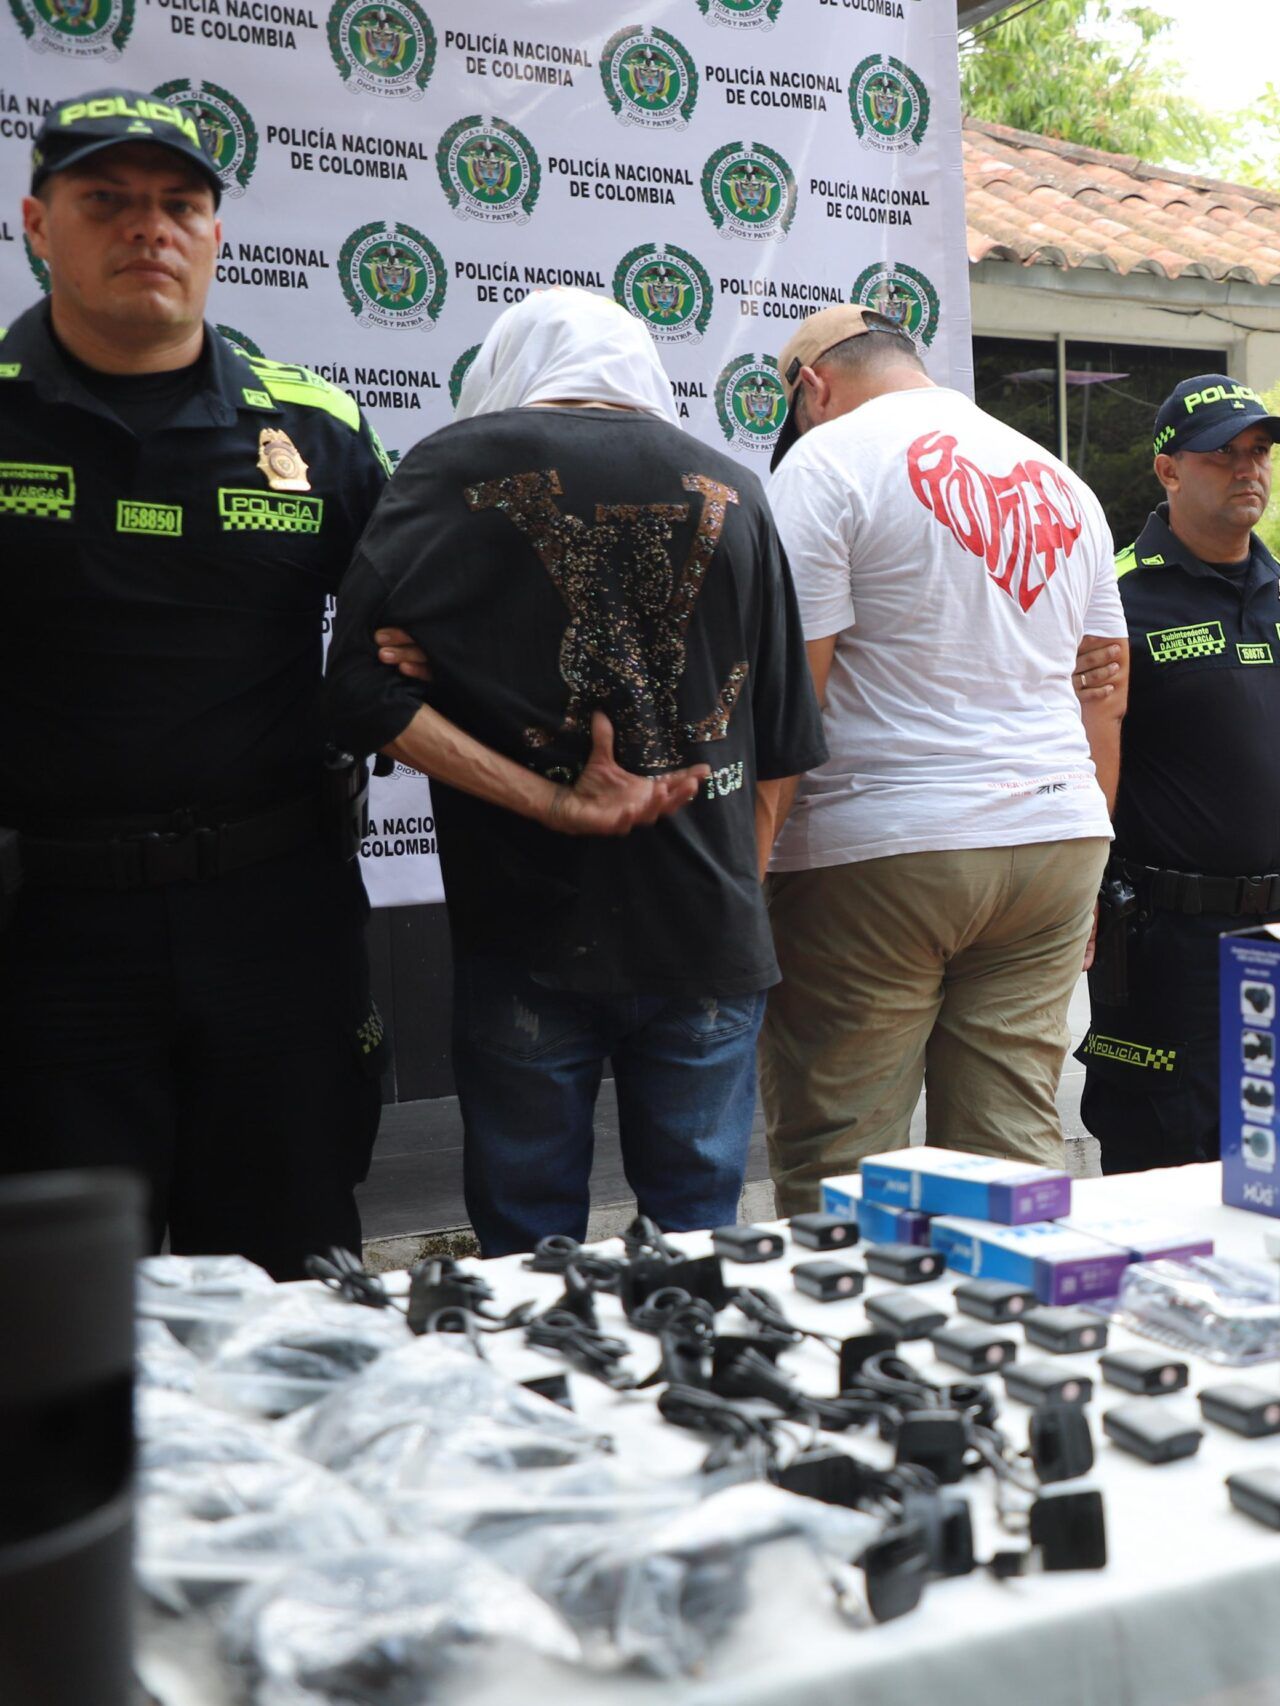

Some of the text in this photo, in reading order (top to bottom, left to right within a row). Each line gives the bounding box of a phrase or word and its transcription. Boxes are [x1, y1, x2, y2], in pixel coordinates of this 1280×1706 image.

[226, 0, 318, 29] NACIONAL
[714, 12, 733, 26] DIOS
[739, 17, 764, 28] PATRIA
[171, 15, 297, 50] DE COLOMBIA
[445, 30, 593, 68] POLICÍA NACIONAL
[613, 36, 687, 88] REPUBLICA DE COLOMBIA
[347, 53, 375, 81] POLICIA
[466, 56, 574, 87] DE COLOMBIA
[705, 65, 842, 93] POLICÍA NACIONAL
[385, 85, 412, 96] PATRIA
[618, 89, 684, 118] POLICIA NACIONAL
[726, 88, 827, 112] DE COLOMBIA
[191, 92, 245, 149] DE COLOMBIA
[626, 111, 645, 126] DIOS
[652, 116, 678, 127] PATRIA
[267, 126, 428, 161] POLICÍA NACIONAL
[450, 130, 475, 172] REPUBLICA
[502, 135, 529, 179] COLOMBIA
[291, 151, 408, 181] DE COLOMBIA
[548, 157, 694, 186] POLICÍA NACIONAL
[713, 156, 736, 195] REPUBLICA
[762, 158, 786, 199] COLOMBIA
[455, 182, 526, 210] POLICIA NACIONAL
[570, 180, 675, 205] DE COLOMBIA
[810, 179, 930, 206] POLICÍA NACIONAL
[465, 206, 484, 219] DIOS
[492, 210, 519, 221] PATRIA
[720, 204, 745, 227] POLICIA
[827, 201, 912, 226] DE COLOMBIA
[729, 225, 746, 237] DIOS
[239, 243, 330, 268] NACIONAL
[352, 236, 378, 279] REPUBLICA
[407, 240, 434, 285] COLOMBIA
[215, 265, 309, 290] COLOMBIA
[455, 261, 605, 288] POLICÍA NACIONAL
[625, 257, 649, 297] REPUBLICA
[676, 260, 701, 300] COLOMBIA
[358, 289, 431, 317] POLICIA NACIONAL
[477, 285, 498, 303] DE
[720, 278, 845, 304] POLICÍA NACIONAL
[905, 277, 928, 315] COLOMBIA
[368, 313, 388, 327] DIOS
[396, 317, 424, 328] PATRIA
[667, 310, 699, 332] NACIONAL
[740, 300, 759, 316] DE
[667, 331, 692, 341] PATRIA
[355, 368, 441, 388] NACIONAL
[727, 368, 748, 407] REPUBLICA
[731, 417, 753, 439] POLICIA
[739, 437, 755, 450] DIOS
[232, 496, 313, 520] POLICÍA
[397, 764, 416, 776] DIOS
[1097, 1042, 1140, 1062] POLICÍA
